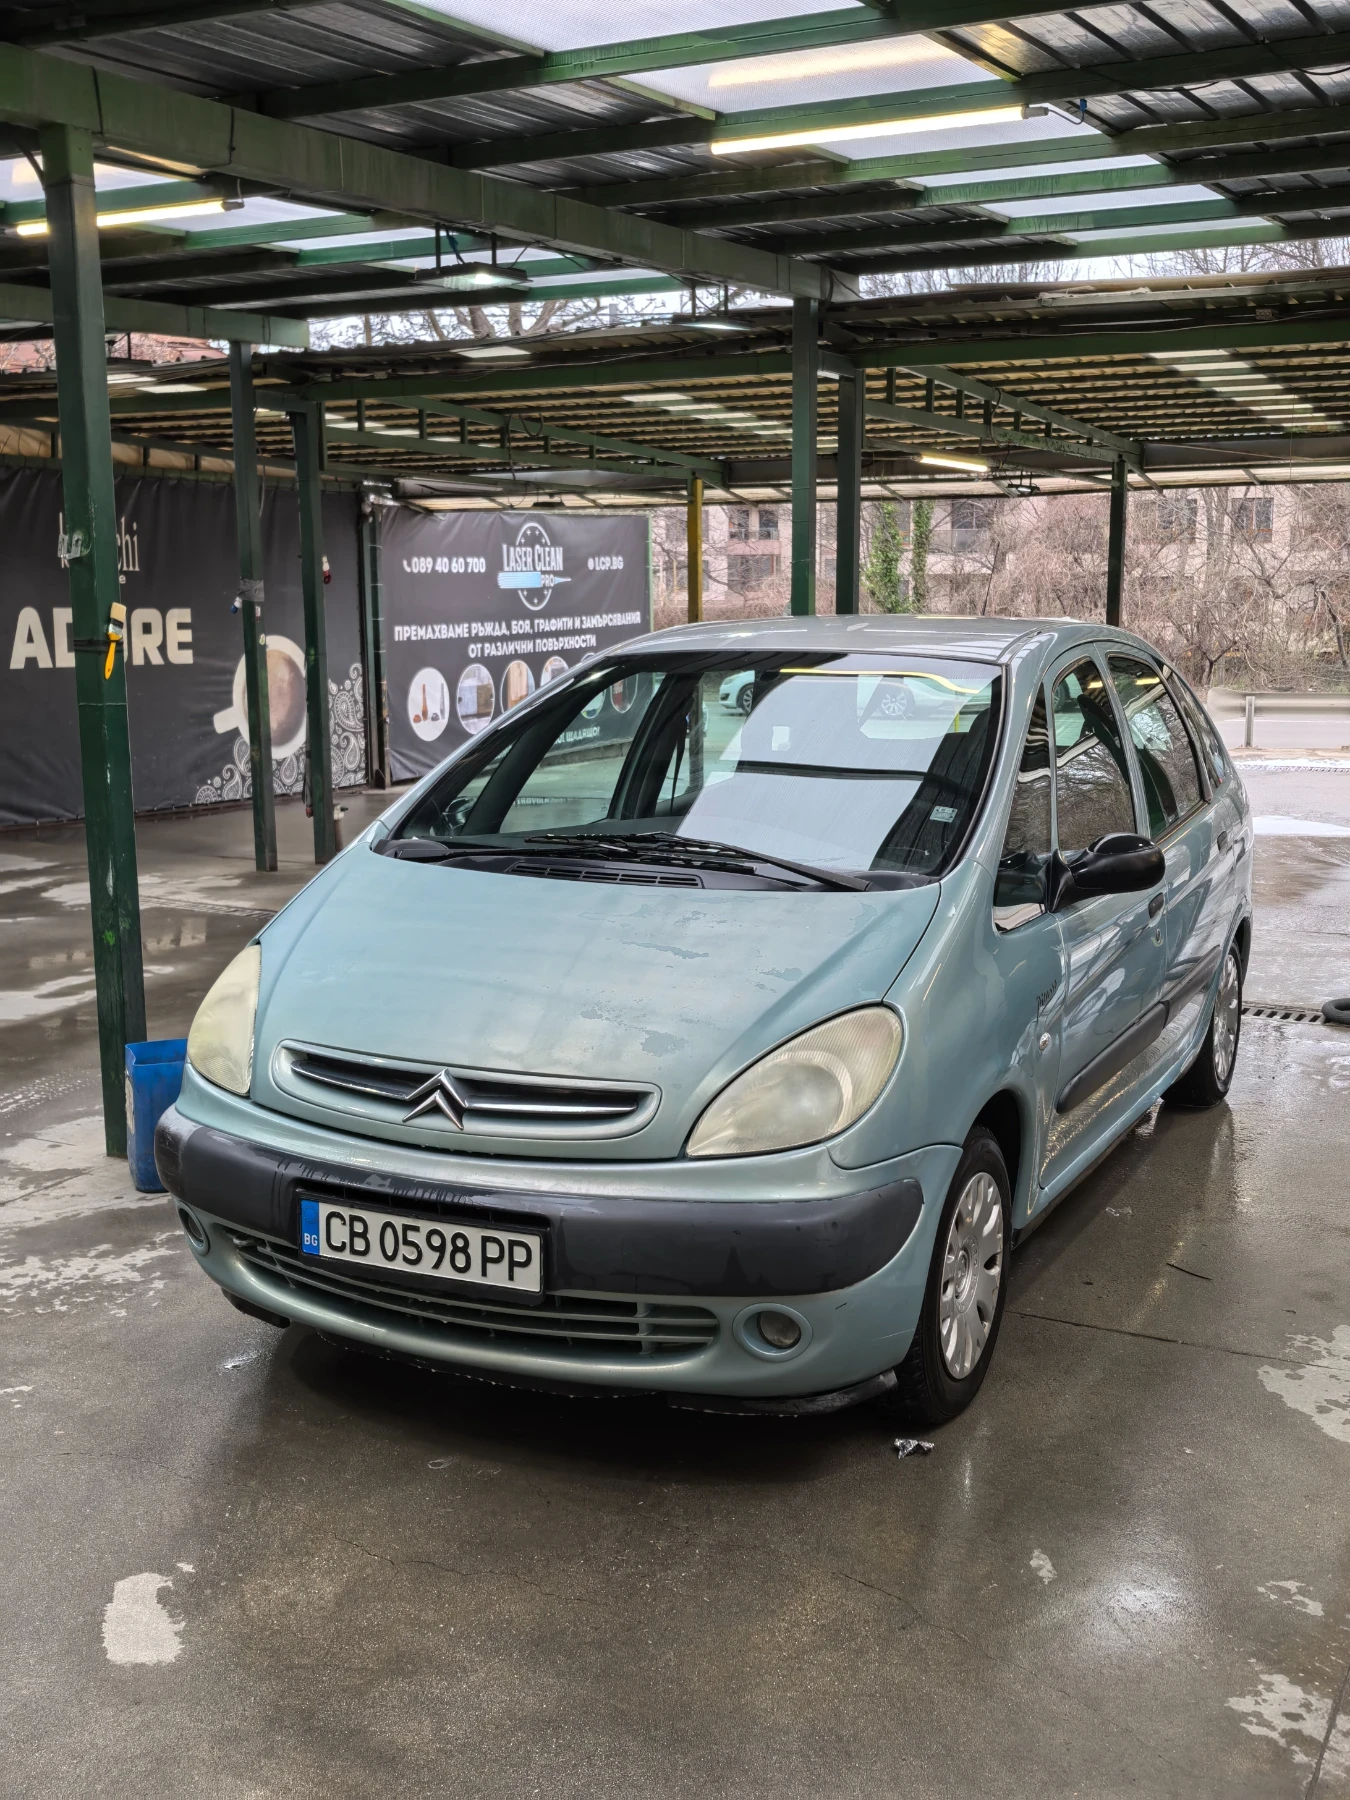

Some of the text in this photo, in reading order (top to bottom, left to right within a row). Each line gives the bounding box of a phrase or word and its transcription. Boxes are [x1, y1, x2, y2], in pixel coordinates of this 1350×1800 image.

[411, 556, 486, 573] 089 40 60 700
[502, 544, 563, 571] LASER CLEAN
[594, 556, 624, 570] LCP.BG
[540, 574, 555, 587] PRO
[9, 606, 194, 669] ADRE
[394, 611, 641, 641] ПРЕМАХВАМЕ РЪЖДА, БОЯ, ГРАФИТИ И ЗАМЪРСЯВАНИЯ
[468, 634, 596, 658] ОТ РАЗЛИЧНИ ПОВЪРХНОСТИ
[303, 1232, 319, 1247] BG
[325, 1210, 533, 1282] CB 0598 PP
